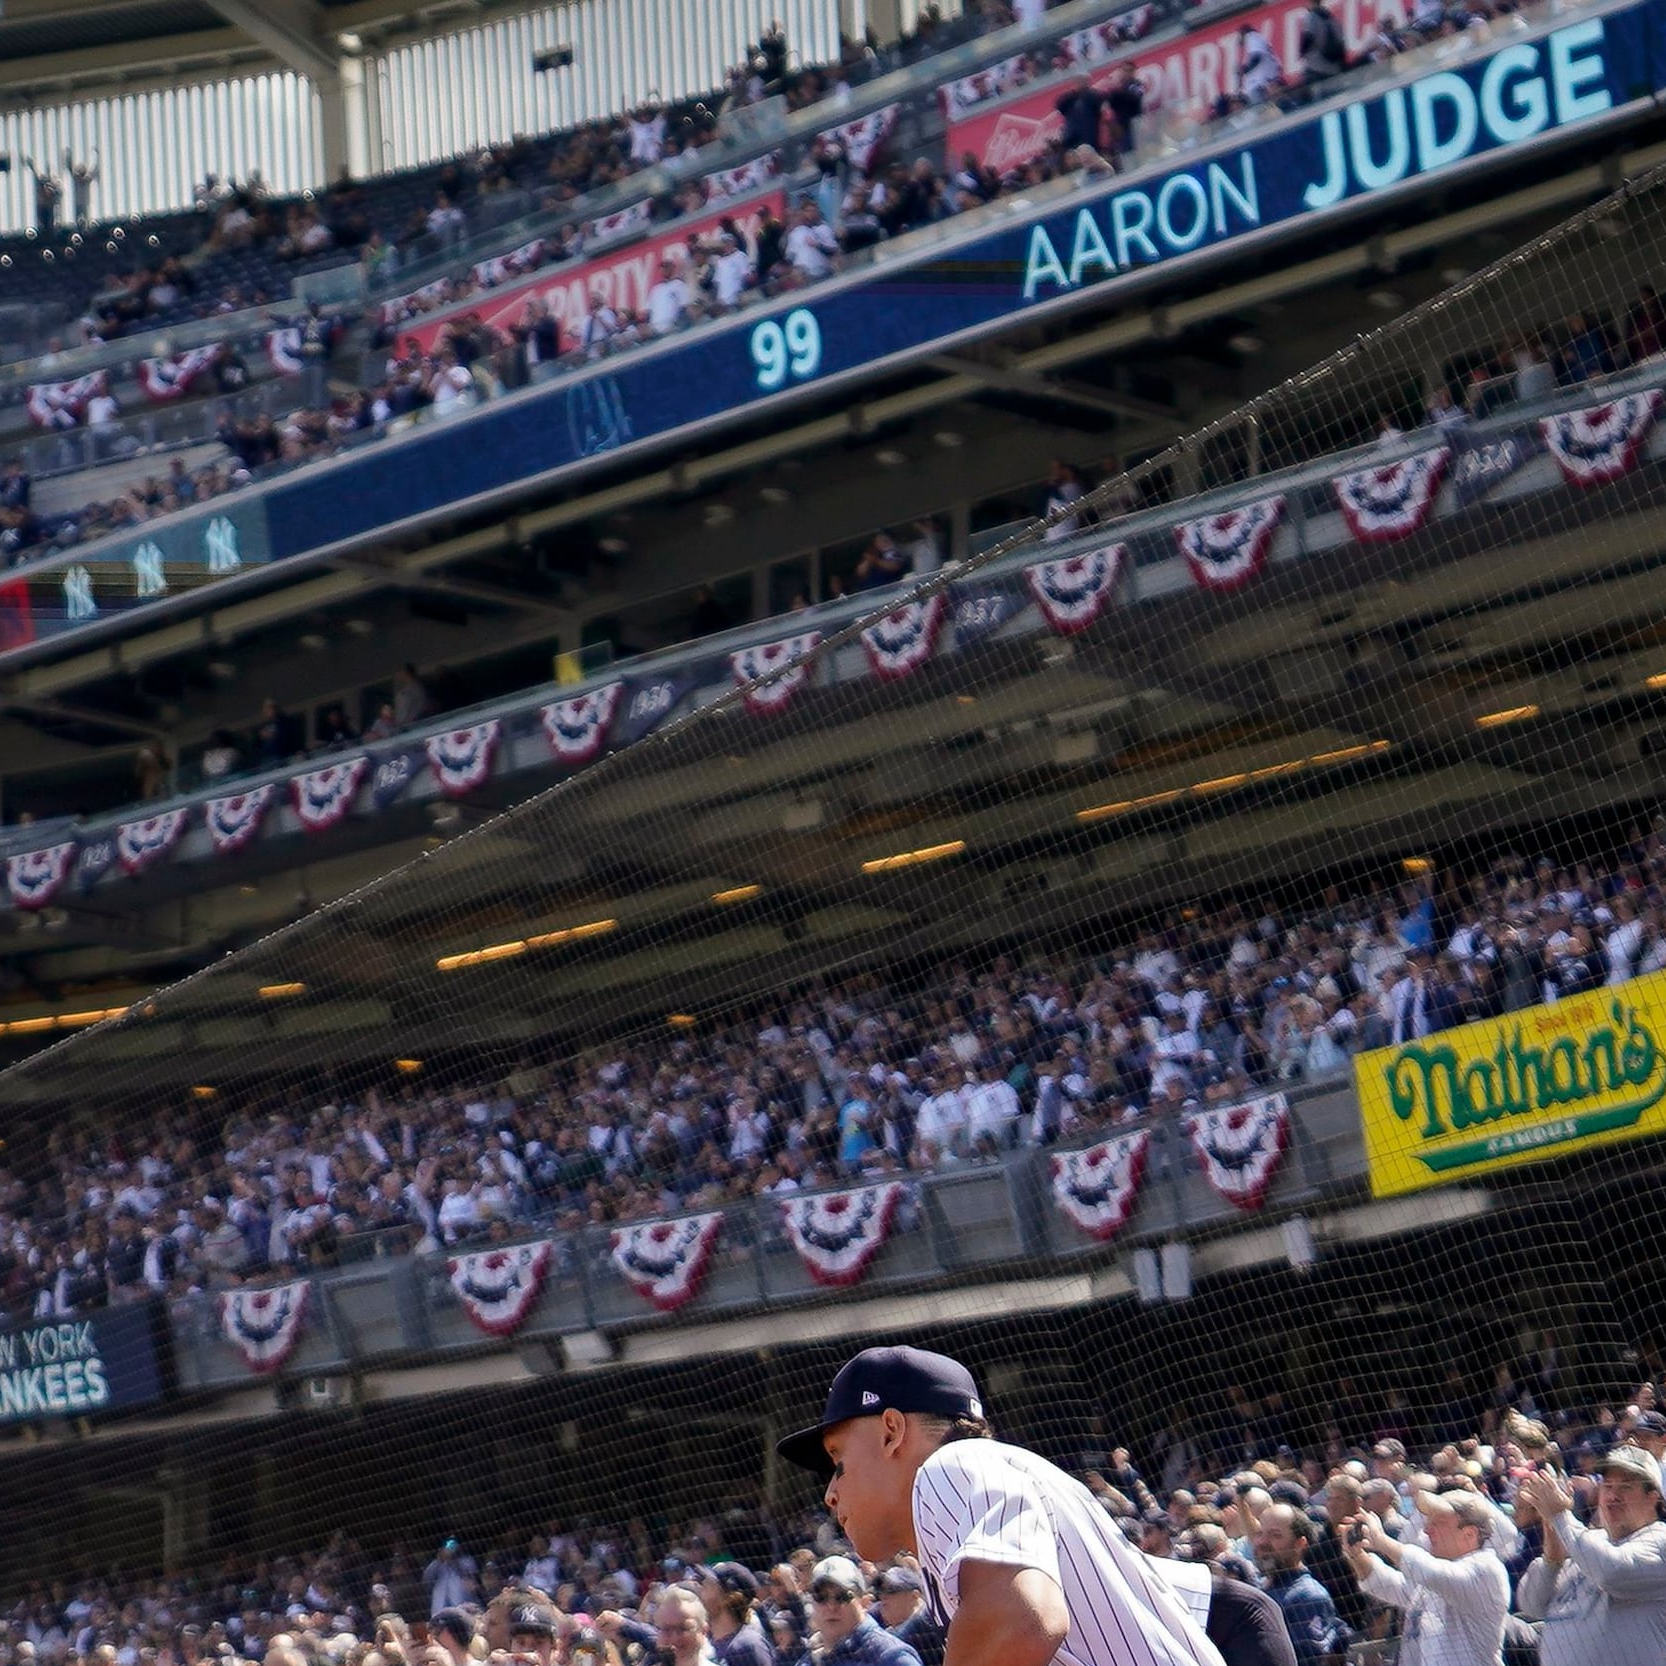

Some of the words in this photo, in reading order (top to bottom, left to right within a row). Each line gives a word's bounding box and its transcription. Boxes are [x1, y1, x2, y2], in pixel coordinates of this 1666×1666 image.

[1023, 150, 1260, 299] AARON
[1303, 18, 1613, 211] JUDGE
[750, 307, 822, 389] 99
[1386, 999, 1657, 1139] Nathan's
[23, 1320, 99, 1364] YORK
